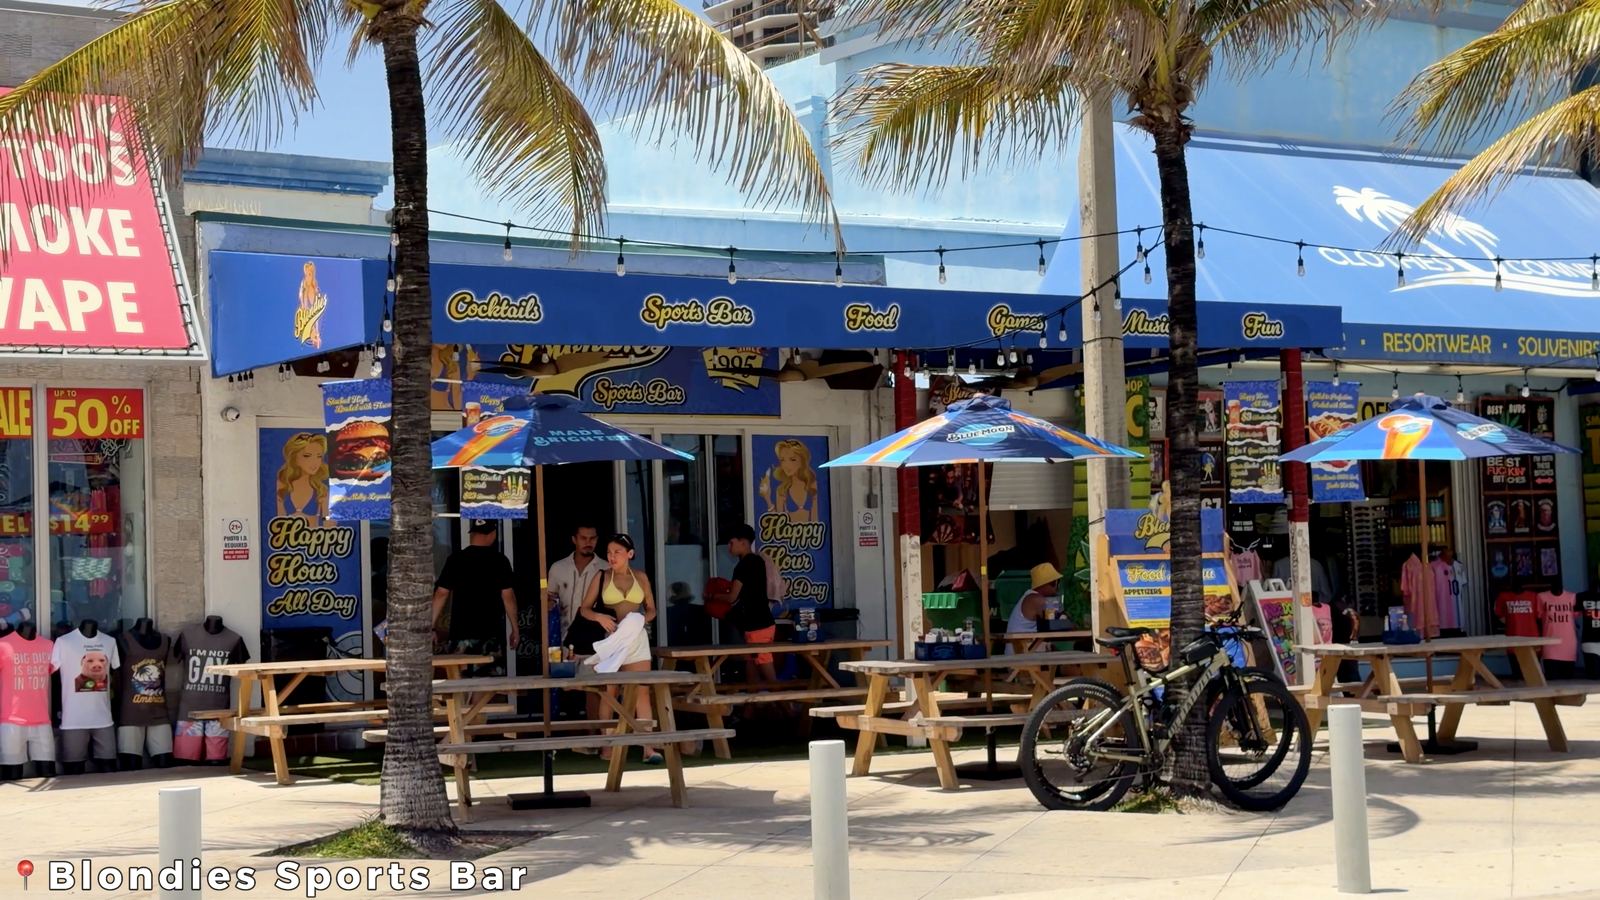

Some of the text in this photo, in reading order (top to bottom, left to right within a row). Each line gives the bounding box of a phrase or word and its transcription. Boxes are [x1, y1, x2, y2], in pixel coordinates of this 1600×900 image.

[448, 291, 543, 323] Cocktails
[641, 294, 754, 331] Sports Bar
[845, 303, 899, 332] Food
[987, 303, 1047, 337] Games
[1122, 308, 1170, 336] Musi
[1243, 312, 1284, 338] Fun
[1383, 332, 1491, 354] RESORTWEAR
[592, 378, 685, 411] Sports Bar
[110, 419, 140, 435] OFF
[533, 434, 631, 447] BRIGHTER
[981, 425, 1014, 436] MOON
[269, 517, 353, 557] Happy
[760, 513, 825, 549] Happy
[268, 552, 338, 586] Hour
[1127, 563, 1166, 584] Food
[268, 589, 357, 619] All Day
[791, 576, 829, 604] Day
[188, 656, 229, 685] GAY
